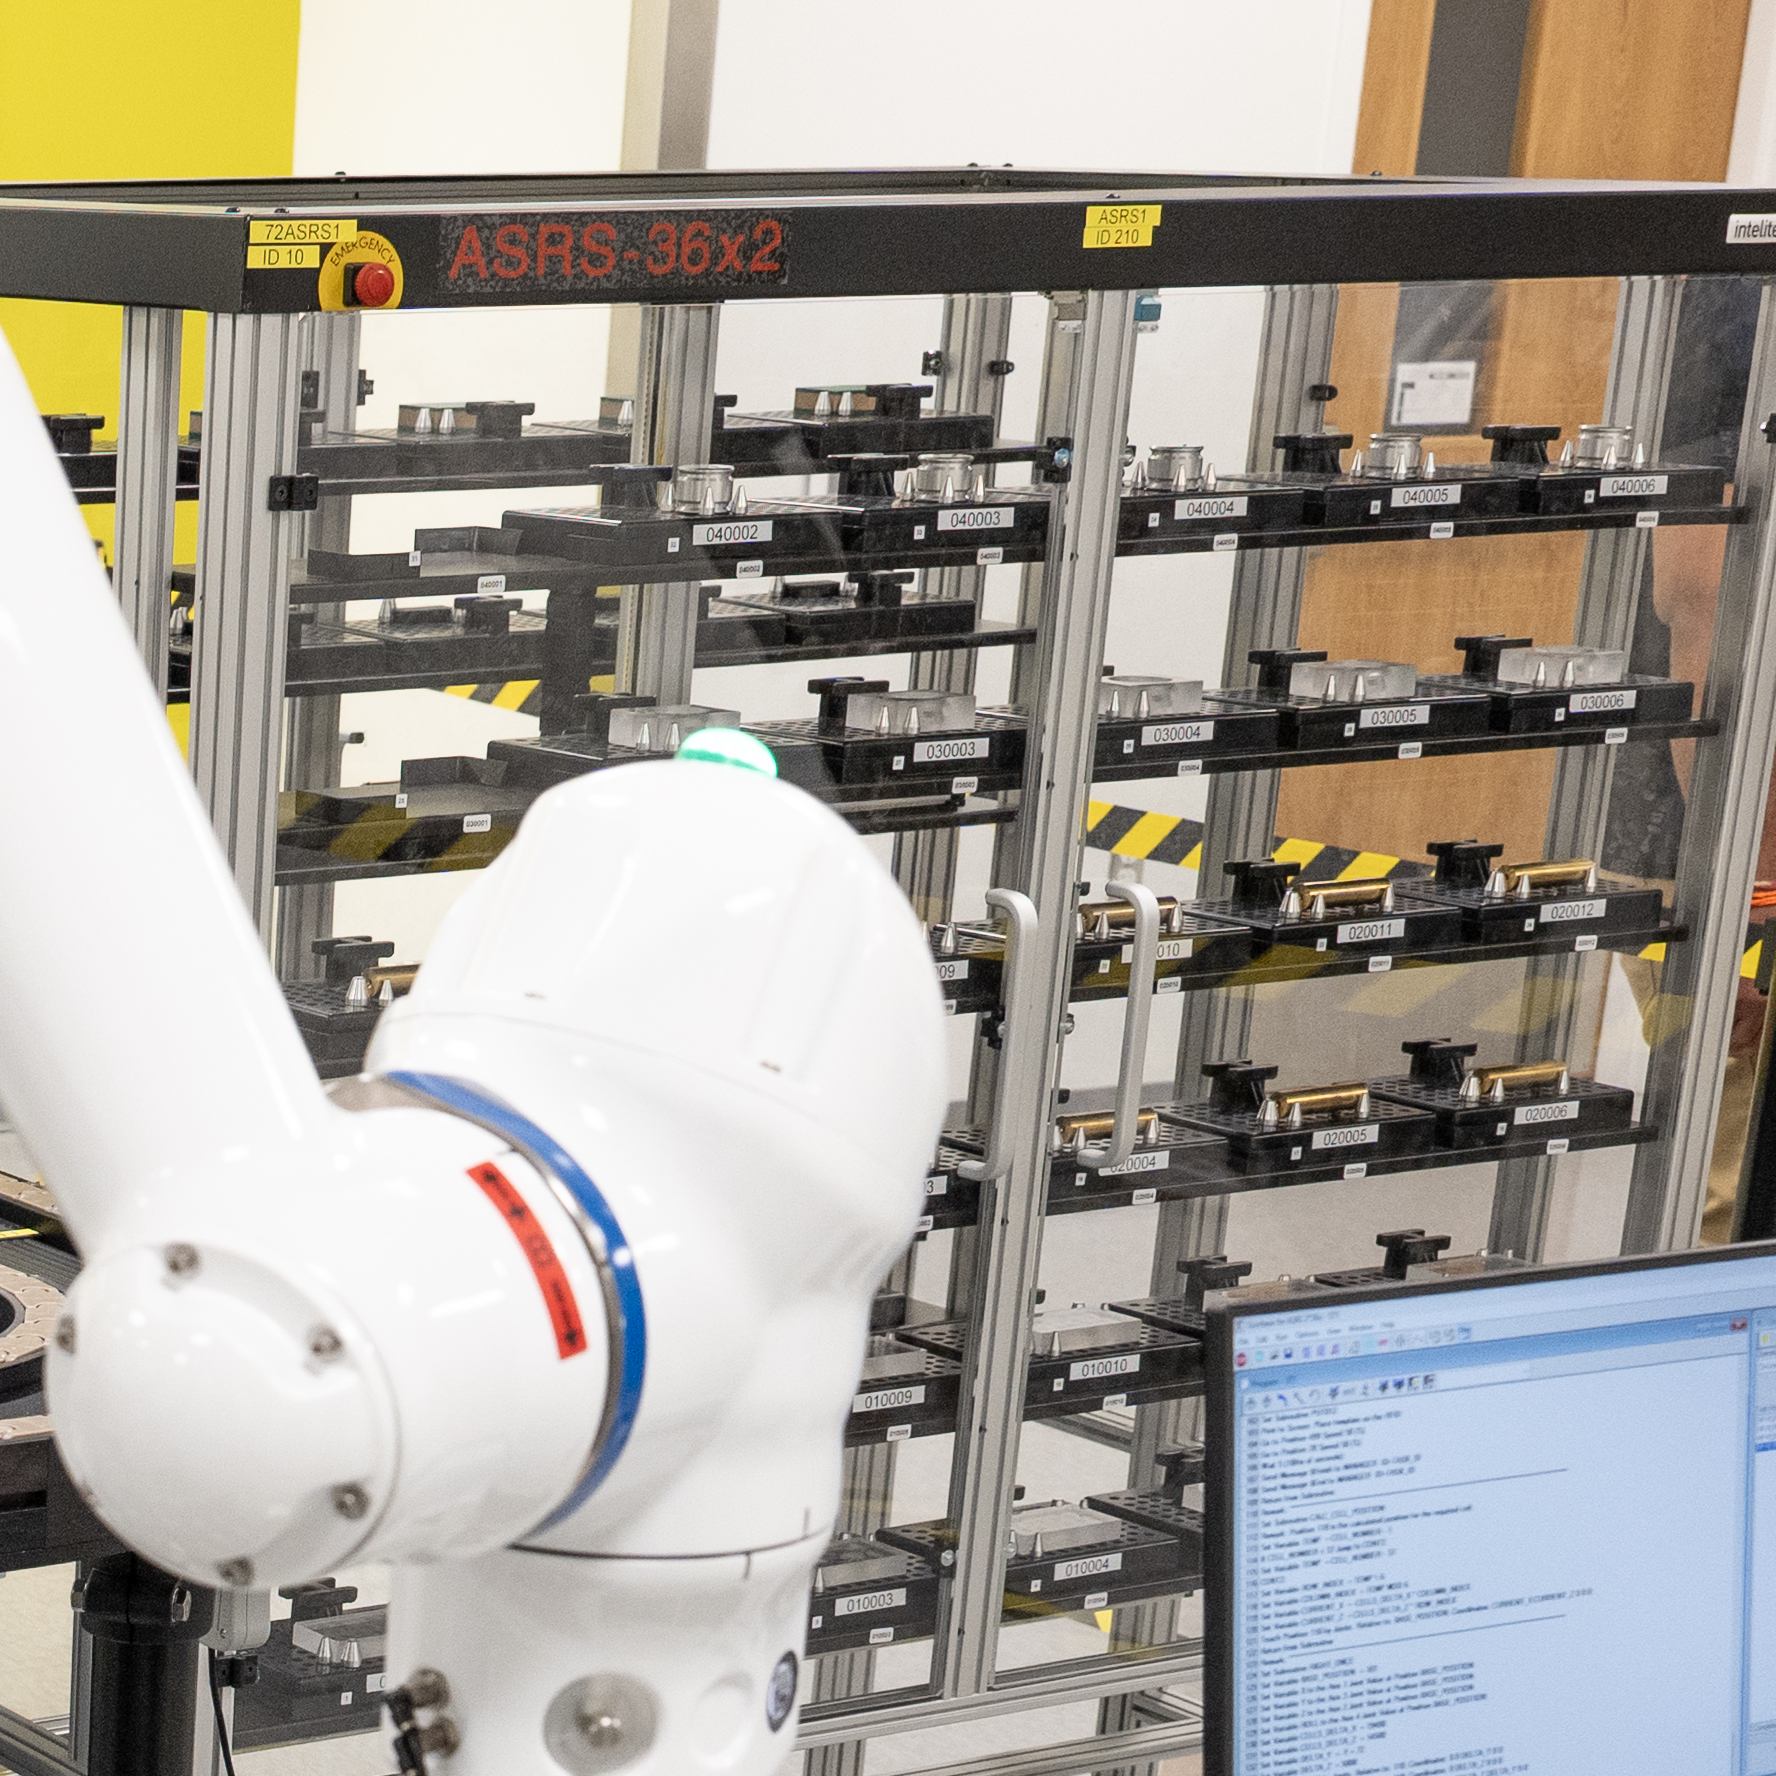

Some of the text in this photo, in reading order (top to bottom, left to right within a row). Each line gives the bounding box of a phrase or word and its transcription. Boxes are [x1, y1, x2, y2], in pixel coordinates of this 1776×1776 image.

[1097, 207, 1148, 226] ASRS1
[265, 223, 341, 241] 72ASRS1
[1096, 227, 1140, 246] ID 210
[263, 248, 304, 266] ID 10
[329, 234, 396, 267] EMERGENCY
[448, 219, 783, 280] ASRS-36x2
[1403, 488, 1449, 504] 040005
[1611, 479, 1656, 495] 040006
[1186, 500, 1234, 518] 040004
[951, 510, 1001, 528] 040003
[706, 525, 758, 543] 040002
[1580, 694, 1624, 711] 030006
[1370, 708, 1417, 726] 030005
[1153, 725, 1201, 743] 030004
[925, 740, 976, 760] 030003
[1551, 903, 1594, 920] 020012
[1348, 923, 1393, 941] 020011
[1525, 1104, 1569, 1122] 020006
[1324, 1129, 1368, 1148] 020005
[1081, 1358, 1128, 1378] 010010
[864, 1390, 912, 1409] 010009
[1065, 1557, 1109, 1577] 010004
[846, 1593, 893, 1612] 010003
